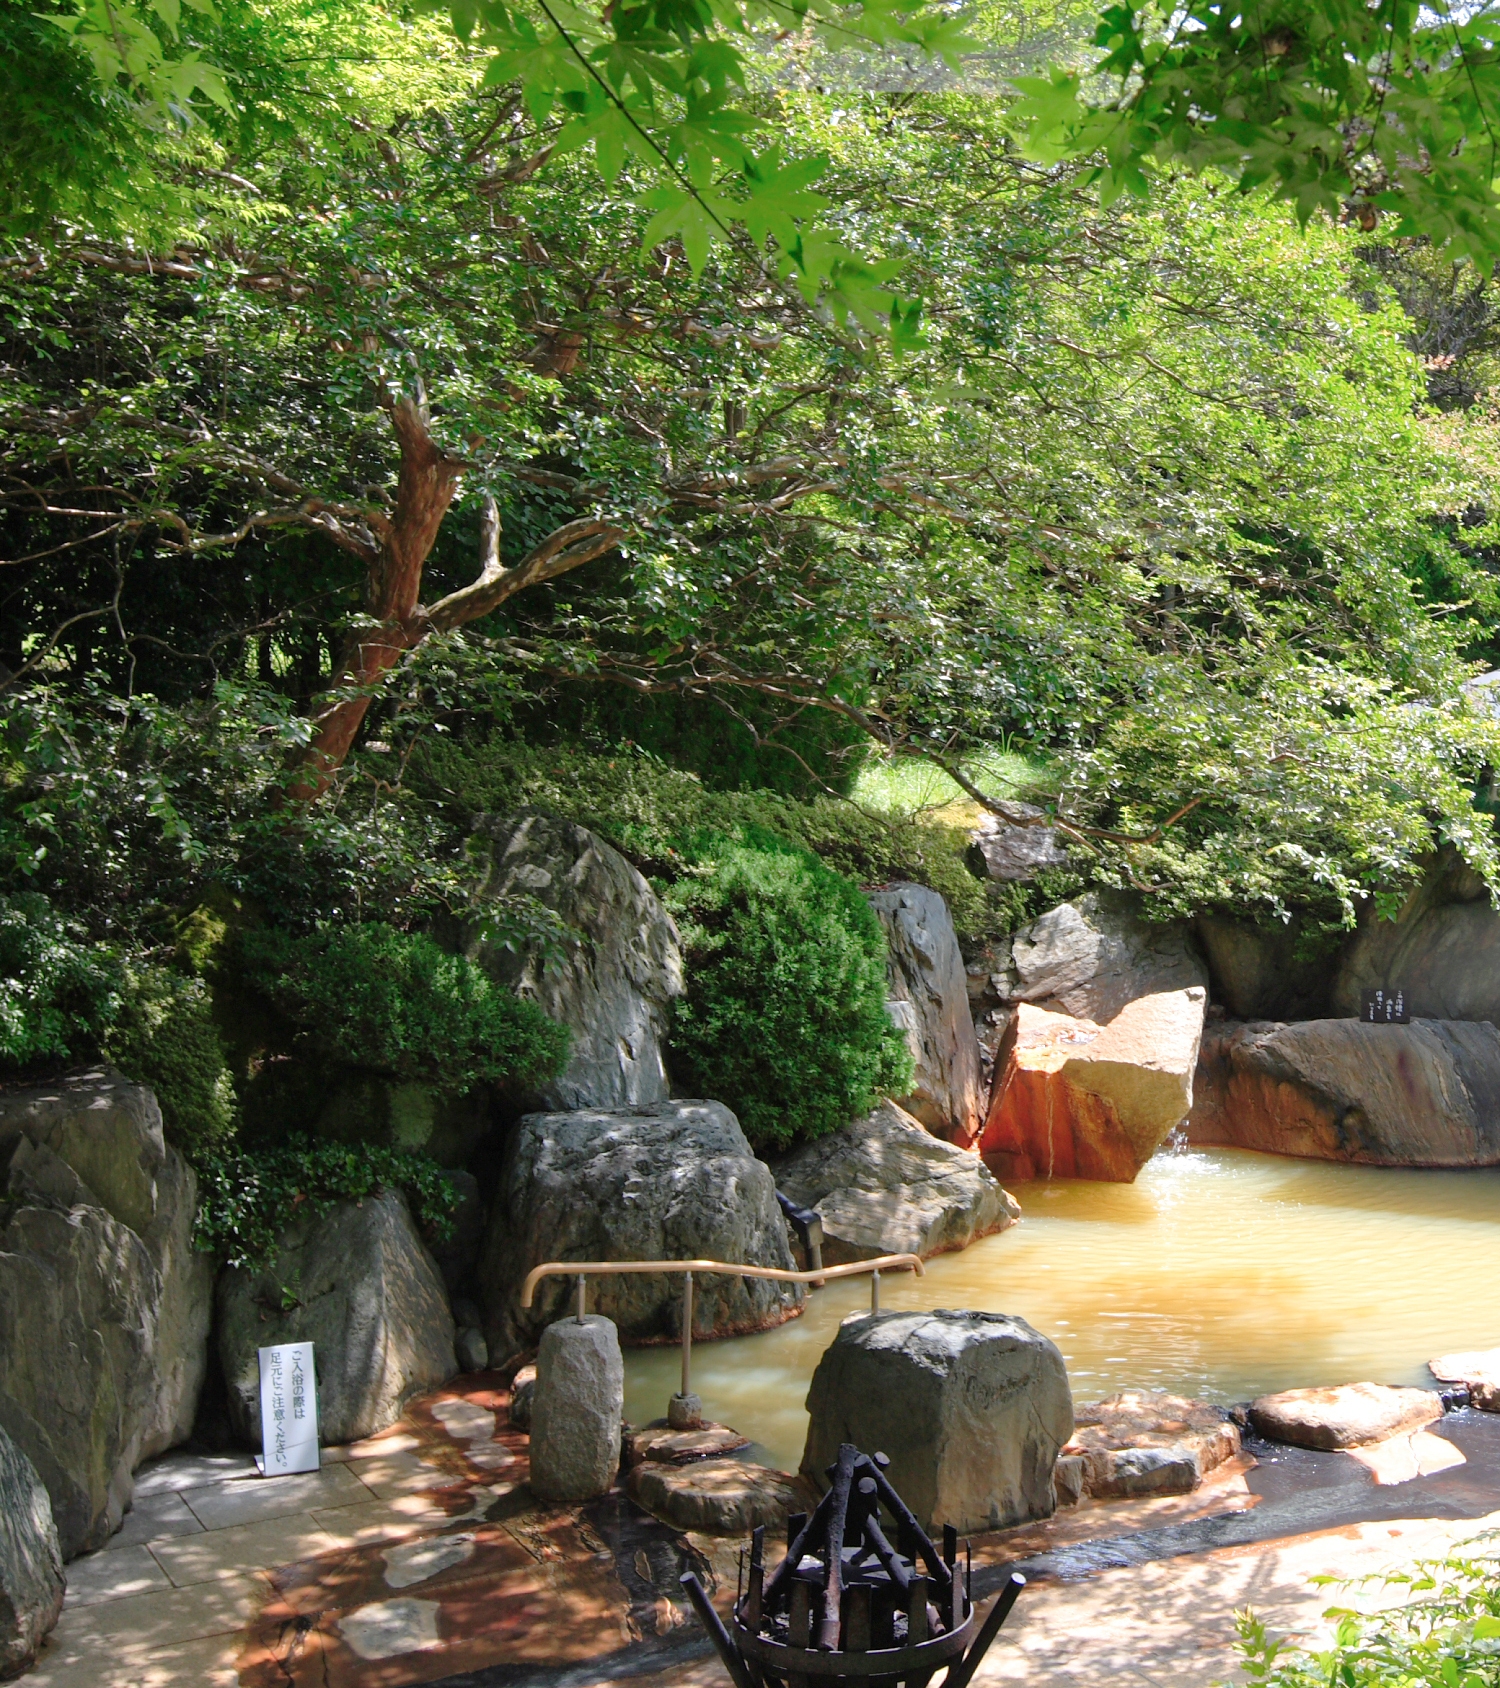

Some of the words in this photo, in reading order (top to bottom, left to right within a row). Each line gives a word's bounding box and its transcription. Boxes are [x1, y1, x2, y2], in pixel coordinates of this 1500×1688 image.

[270, 1352, 288, 1467] 足元にご注意ください。
[291, 1350, 306, 1420] ご入浴の際は
